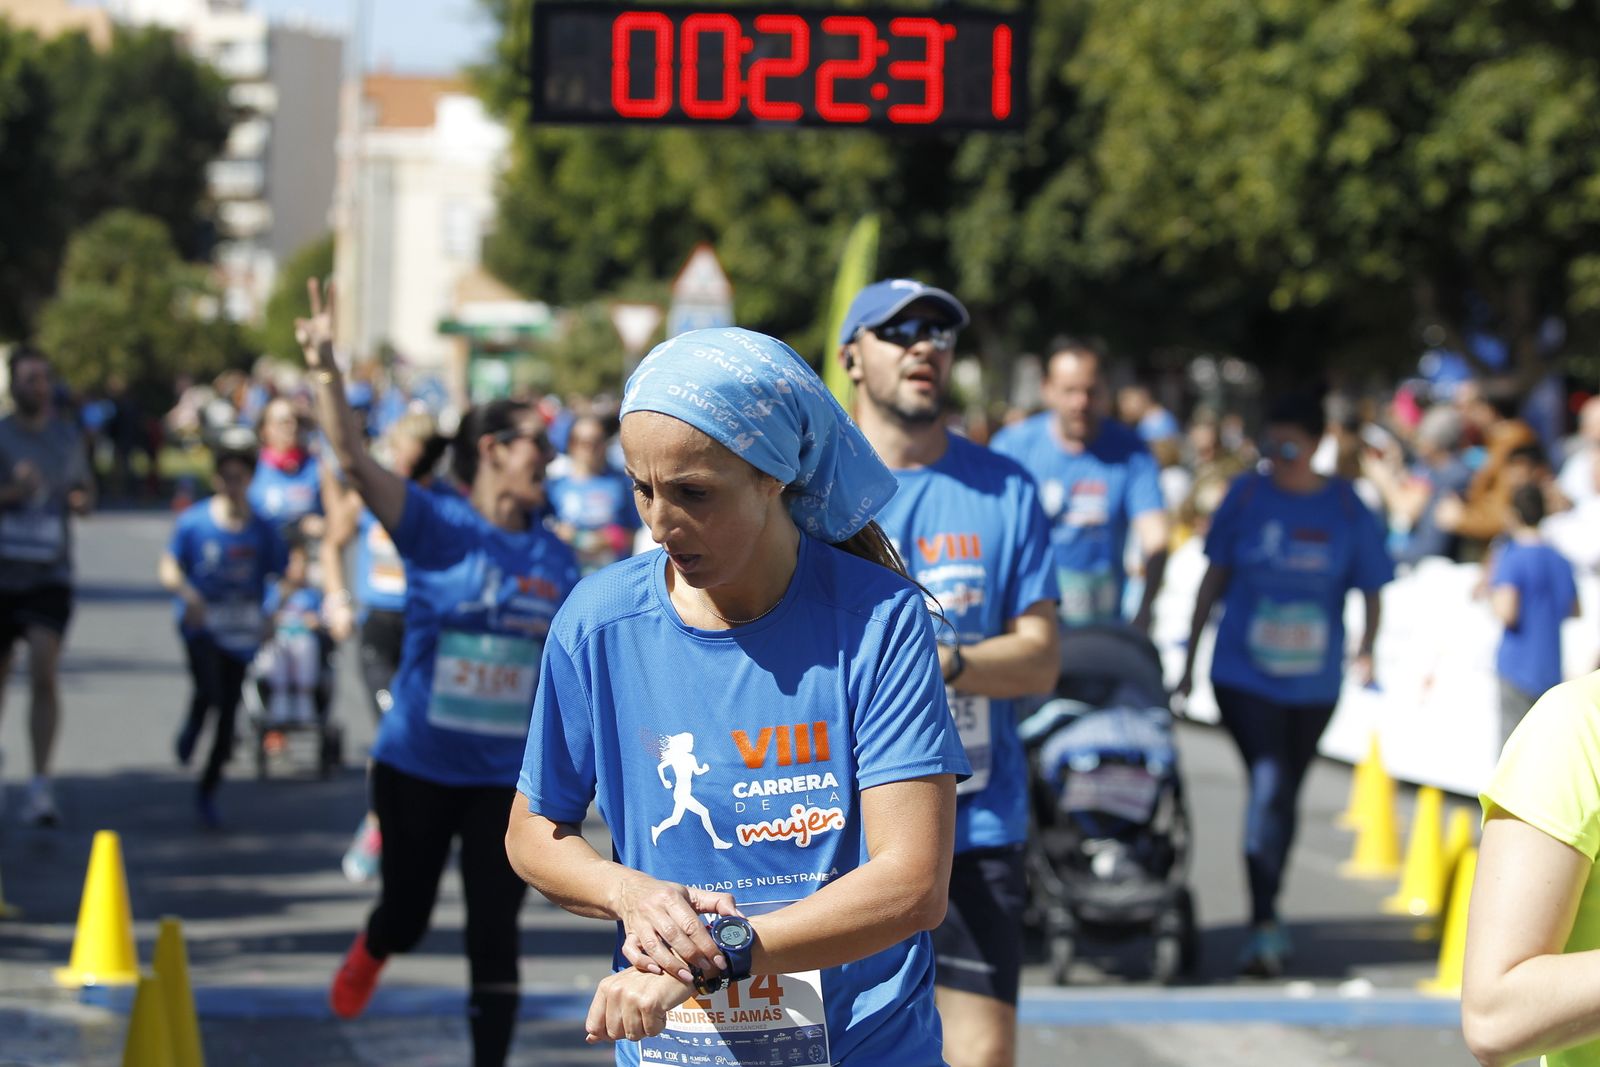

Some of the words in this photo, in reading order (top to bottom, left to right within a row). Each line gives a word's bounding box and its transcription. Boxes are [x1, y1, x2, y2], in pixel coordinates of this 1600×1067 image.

[917, 533, 982, 566] VIII
[731, 721, 831, 769] VIII
[733, 772, 839, 798] CARRERA
[737, 878, 753, 889] ES
[756, 871, 818, 886] NUESTRA
[666, 1011, 726, 1024] ENDIRSE
[731, 1006, 783, 1023] JAMÁS
